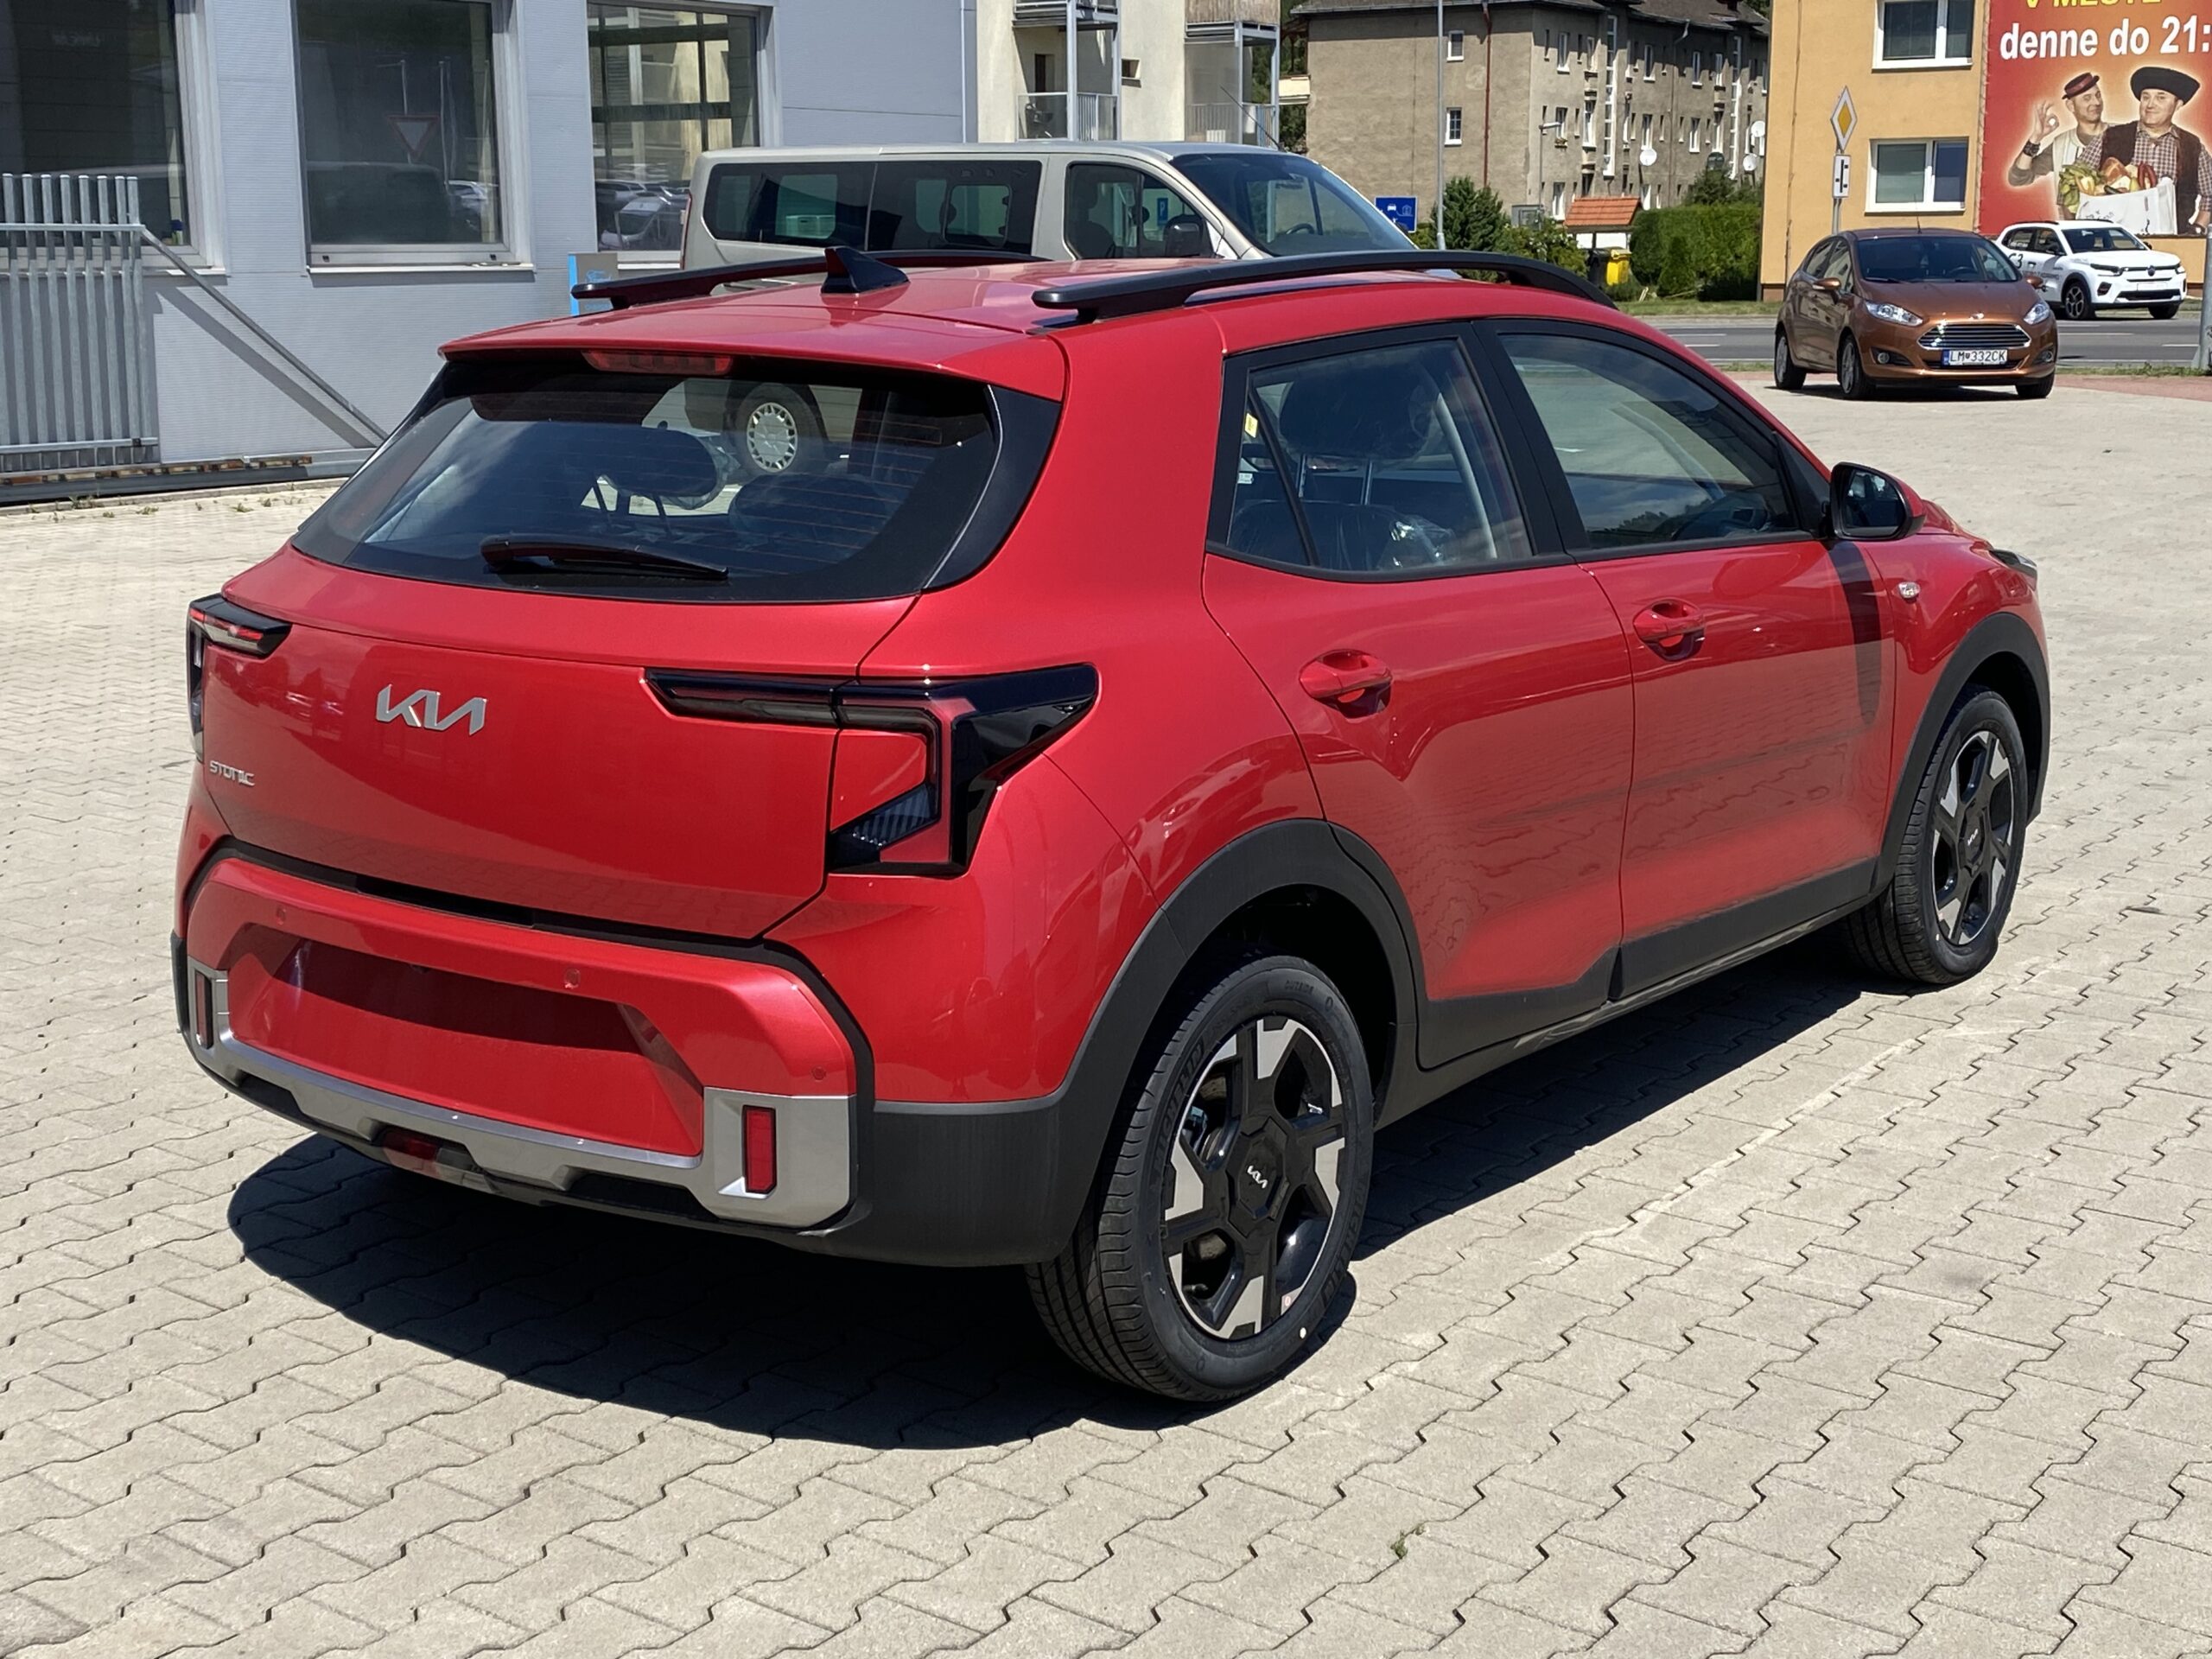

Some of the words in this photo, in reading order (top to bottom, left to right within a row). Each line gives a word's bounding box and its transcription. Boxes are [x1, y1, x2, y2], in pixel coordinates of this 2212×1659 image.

[2000, 22, 2099, 60] denne
[2109, 18, 2150, 56] do
[1971, 351, 2005, 362] 332CK
[376, 683, 487, 736] KIA
[210, 760, 256, 787] STONIC
